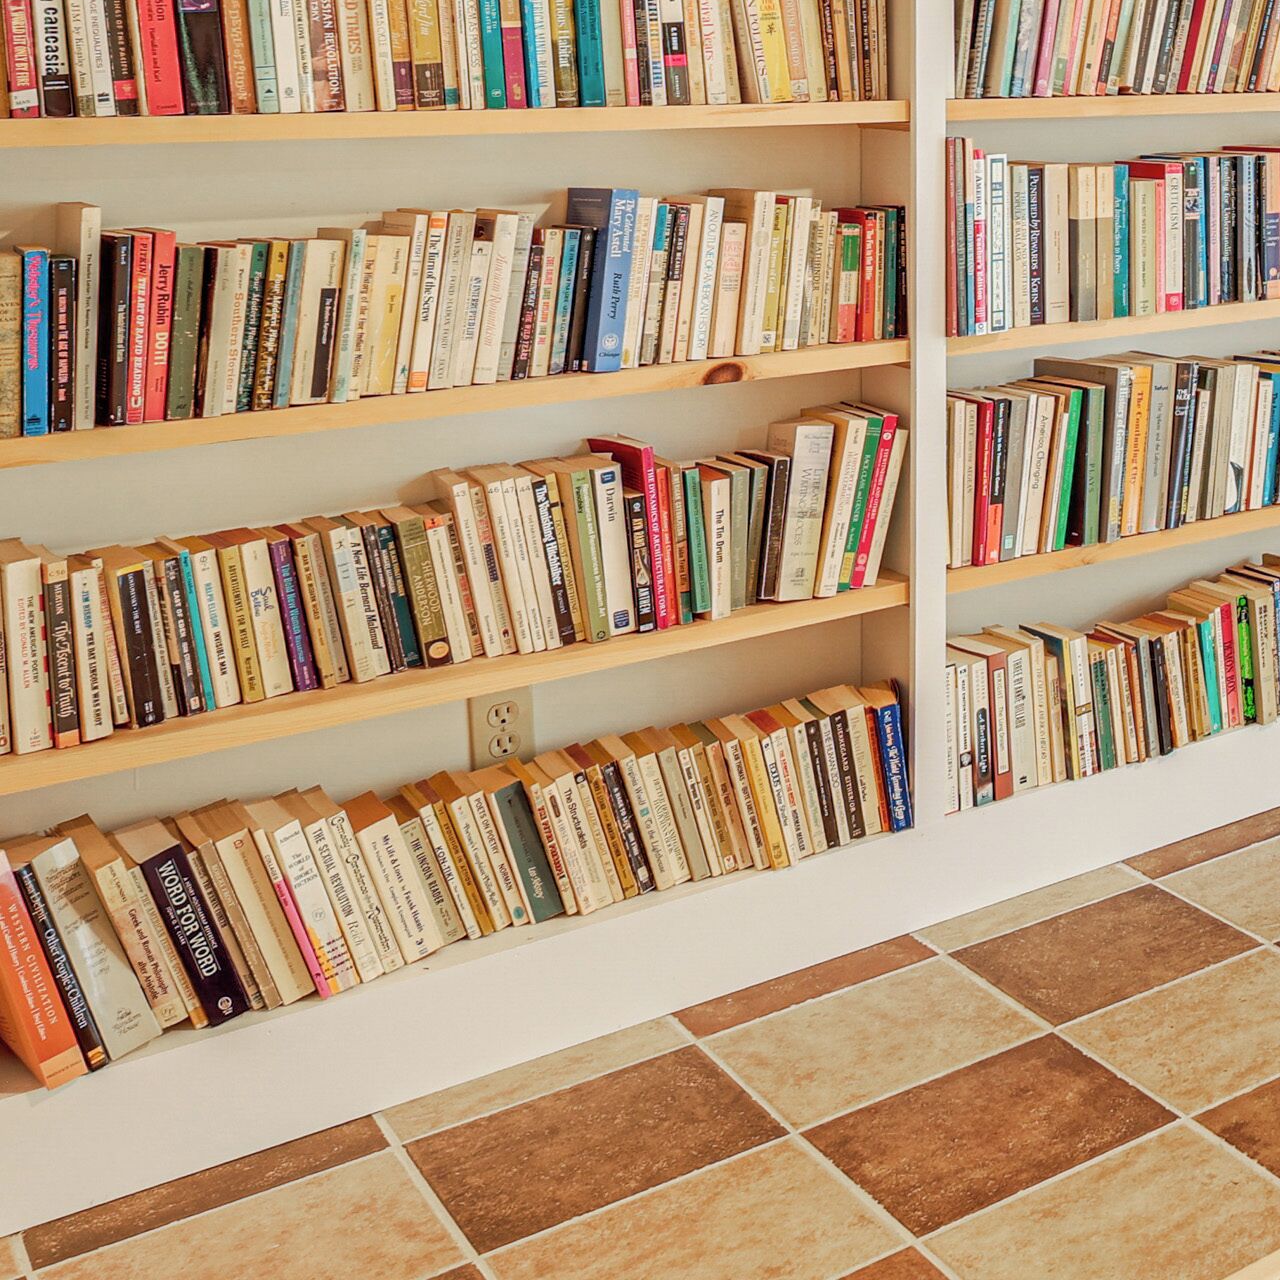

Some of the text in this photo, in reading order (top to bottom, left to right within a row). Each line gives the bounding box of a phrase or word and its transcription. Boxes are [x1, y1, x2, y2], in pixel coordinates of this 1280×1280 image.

[70, 3, 79, 22] JIM
[346, 14, 361, 54] TIMES
[44, 8, 64, 75] caucasia
[91, 16, 102, 68] INEQUALITIES
[325, 33, 339, 94] REVOLUTION
[557, 30, 571, 67] Habitat
[703, 31, 718, 60] Years
[749, 14, 767, 76] POLITICS
[610, 199, 625, 257] Mary Astell
[623, 199, 634, 252] The Celebrated
[1170, 177, 1178, 230] CRITICISM
[1030, 176, 1039, 303] PUNISHED by REWARDS KOHN
[422, 234, 441, 322] The Turn of the Screw
[608, 273, 623, 319] Ruth Perry
[27, 256, 42, 370] Webster's Thesaurus
[132, 243, 147, 396] PITKIN THE ART OF RAPID READING
[155, 264, 171, 348] Jerry Rubin DO
[226, 293, 243, 390] Southern Stories
[605, 487, 617, 522] Darwin
[715, 509, 724, 563] The Tin Drum
[54, 584, 64, 614] MERTON
[259, 587, 272, 612] Saul
[413, 575, 431, 626] ANDERSON
[421, 560, 440, 612] SHERWOOD
[29, 626, 37, 657] AMERICAN
[84, 604, 92, 628] BISHOP
[89, 662, 99, 691] LINCOLN
[214, 632, 228, 676] INVISIBLE MAN
[1226, 641, 1235, 694] DEMON BOX
[92, 693, 100, 707] WAS
[93, 709, 102, 726] SHOT
[474, 798, 513, 891] POETS ON POETRY NORMAN
[563, 789, 588, 849] The Structuralists
[312, 828, 354, 917] THE SEXUAL REVOLUTION
[410, 838, 444, 905] THE LINCOLN READER
[158, 861, 216, 977] WORD FOR WORD
[8, 903, 57, 1025] WESTERN CIVILIZATION
[44, 928, 88, 1029] Other People's Children
